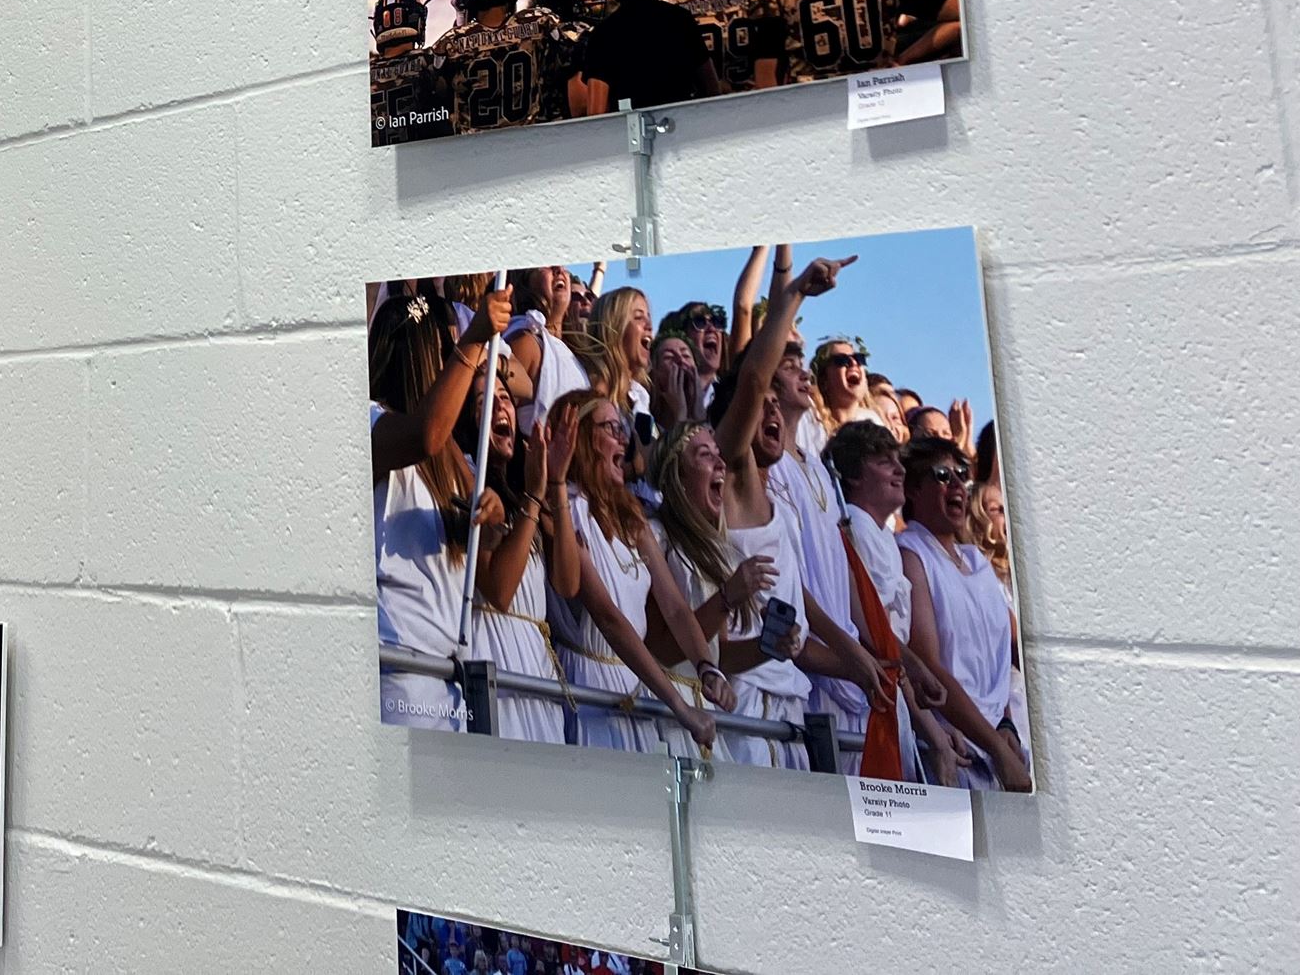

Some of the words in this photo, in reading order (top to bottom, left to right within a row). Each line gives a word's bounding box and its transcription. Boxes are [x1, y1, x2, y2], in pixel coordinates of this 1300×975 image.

[467, 50, 533, 127] 20
[389, 114, 407, 129] Ian
[409, 106, 450, 125] Parrish
[397, 699, 435, 717] Brooke
[438, 704, 474, 721] Morris
[860, 781, 893, 793] Brooke
[894, 784, 928, 796] Morris
[862, 796, 888, 808] Varsity
[889, 799, 911, 809] Photo
[864, 809, 884, 818] Grade
